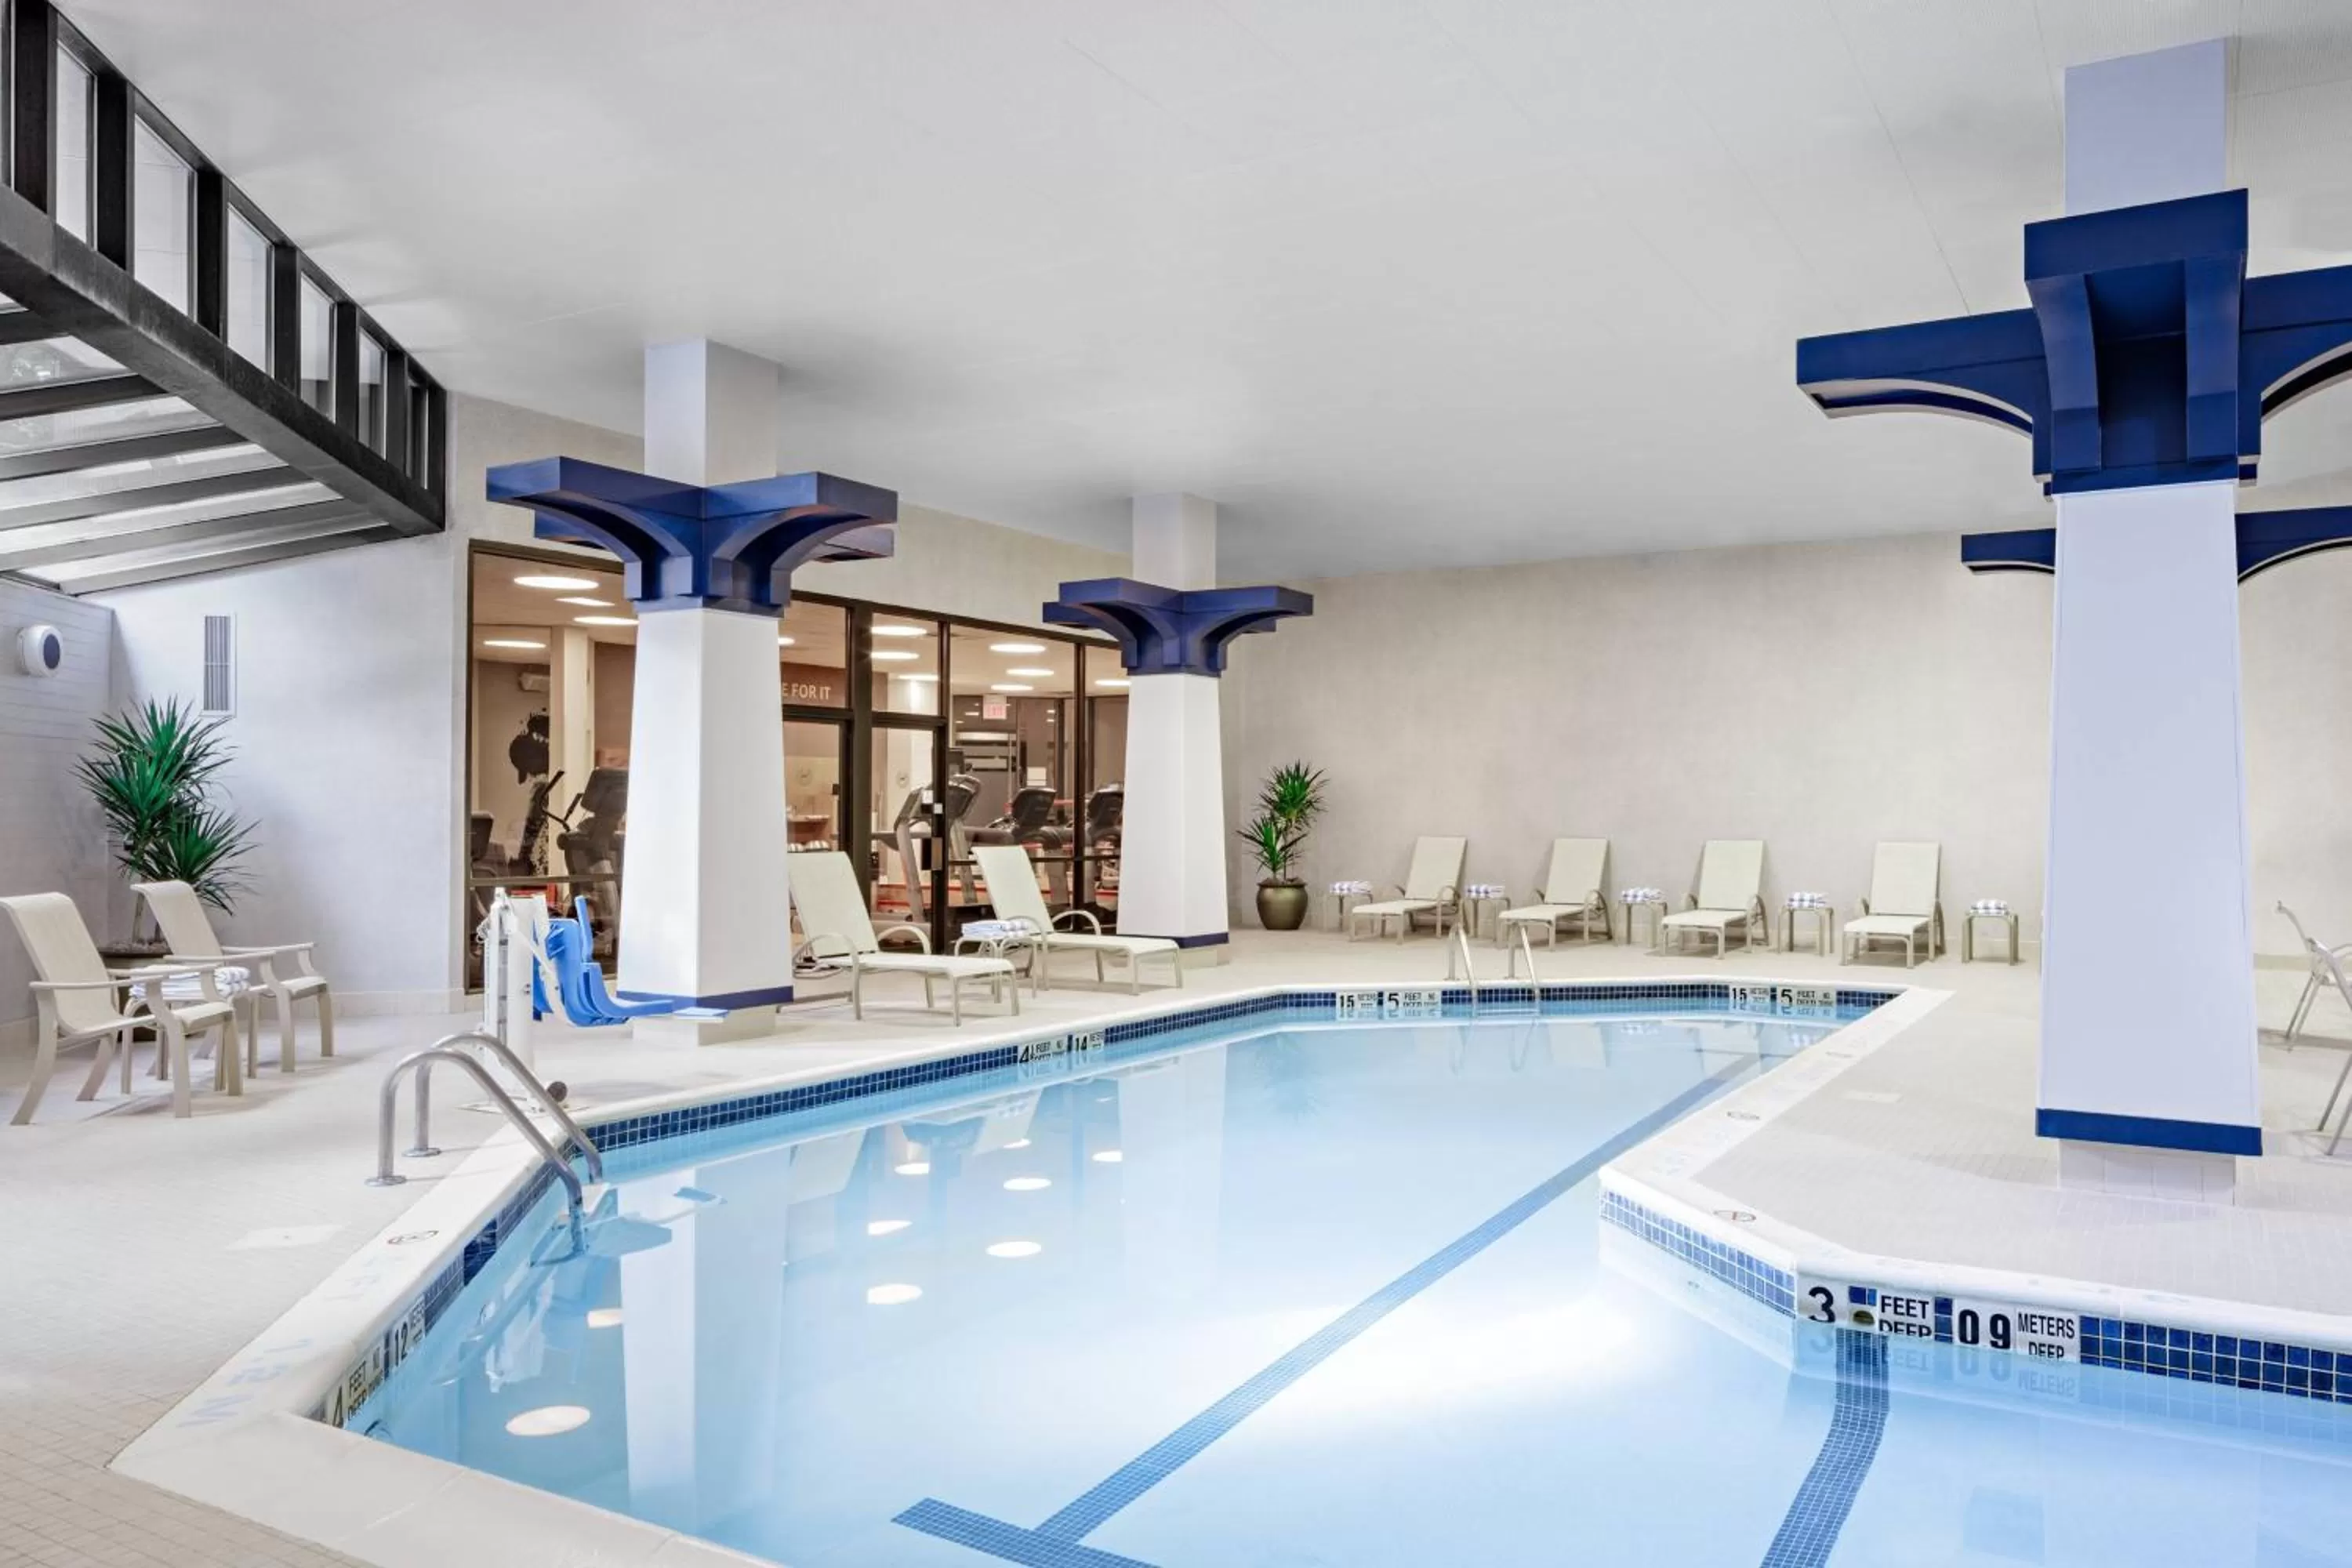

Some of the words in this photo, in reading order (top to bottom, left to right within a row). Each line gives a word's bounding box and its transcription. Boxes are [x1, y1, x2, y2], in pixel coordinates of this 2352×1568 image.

[792, 683, 816, 699] FOR
[819, 686, 832, 700] IT
[1387, 992, 1399, 1009] 5
[1780, 989, 1793, 1003] 5
[1808, 1286, 1835, 1323] 3
[1881, 1294, 1929, 1319] FEET
[2017, 1312, 2075, 1340] METERS
